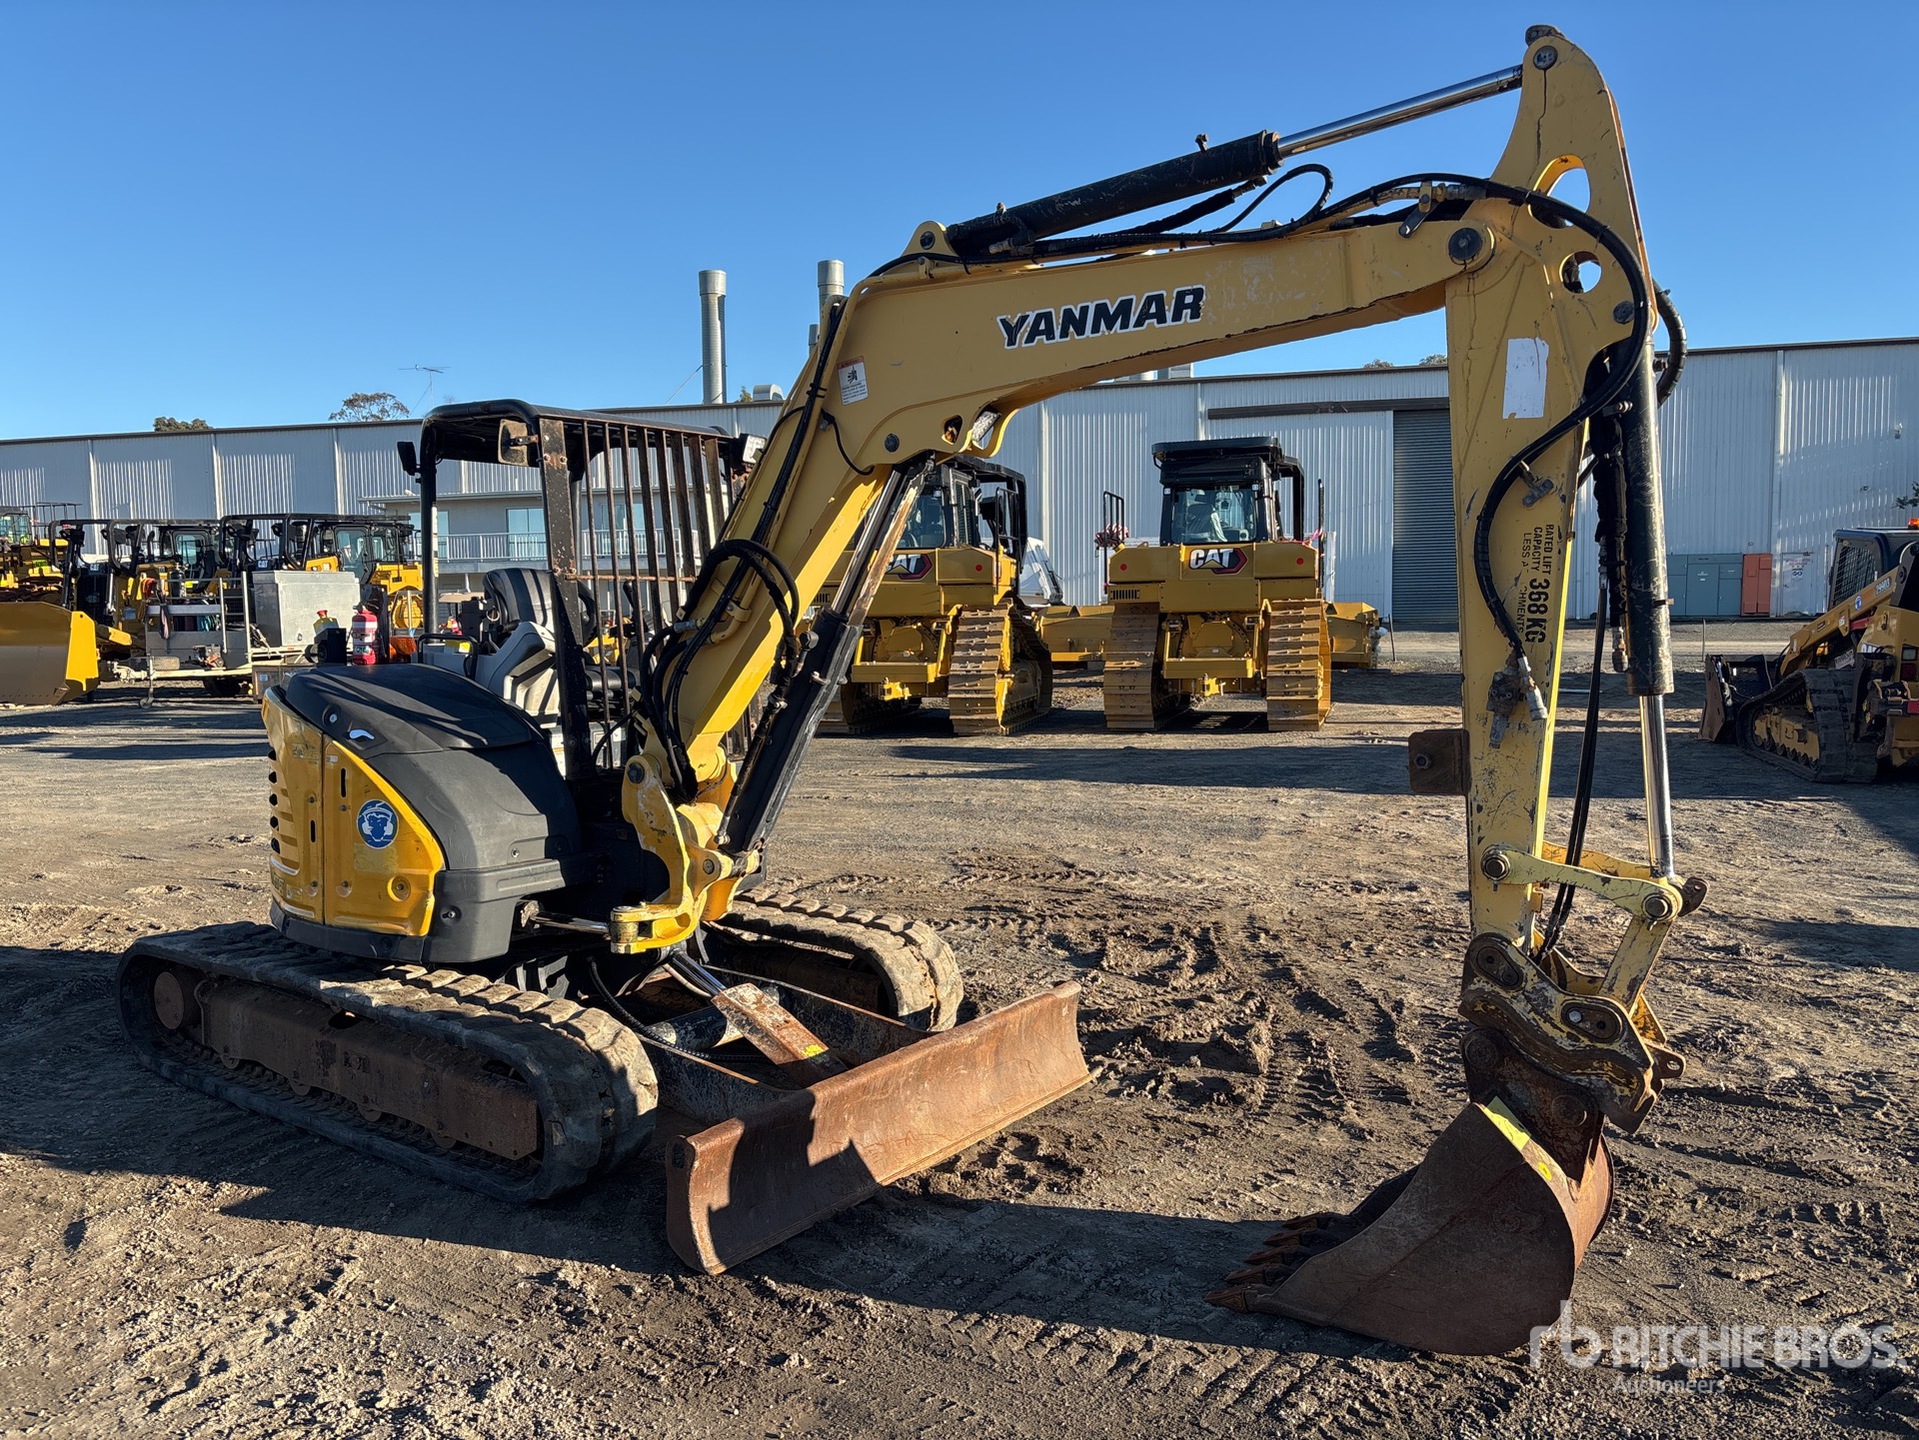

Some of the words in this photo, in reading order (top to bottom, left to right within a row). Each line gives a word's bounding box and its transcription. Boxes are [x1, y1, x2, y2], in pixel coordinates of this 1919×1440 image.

[997, 284, 1206, 349] YANMAR
[1522, 532, 1532, 558] LESS
[1531, 526, 1543, 572] CAPACITY
[1544, 524, 1555, 553] RATED
[257, 560, 269, 568] CAT
[886, 553, 921, 573] AT
[1190, 548, 1234, 569] CAT
[1542, 555, 1552, 575] LIFT
[1527, 578, 1551, 615] 368
[1525, 618, 1547, 643] KG
